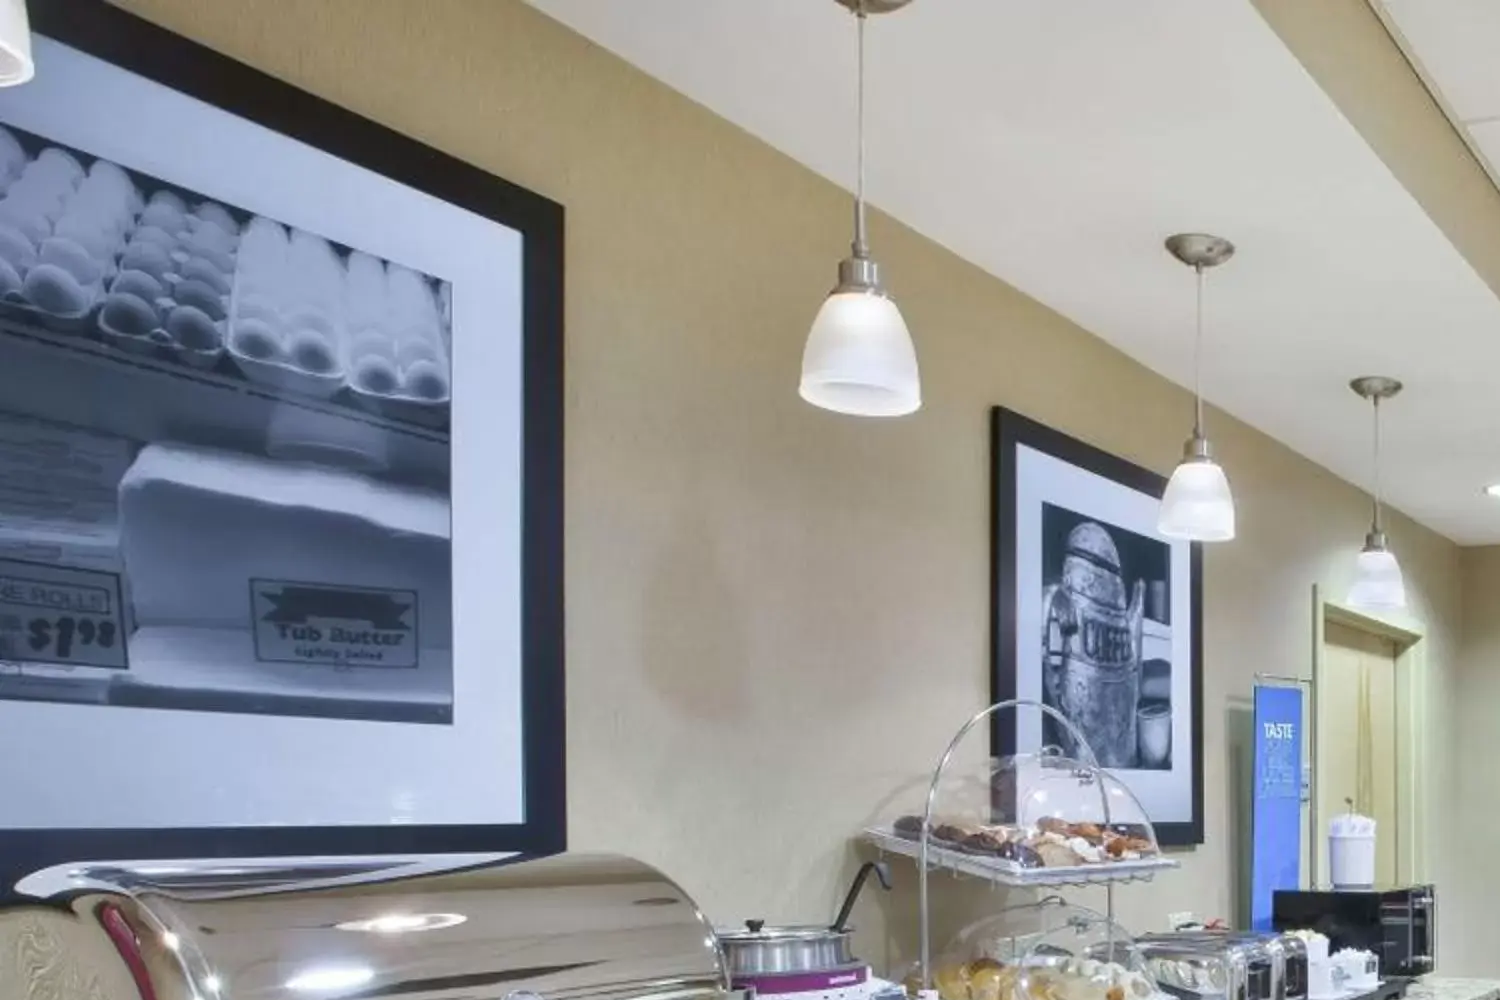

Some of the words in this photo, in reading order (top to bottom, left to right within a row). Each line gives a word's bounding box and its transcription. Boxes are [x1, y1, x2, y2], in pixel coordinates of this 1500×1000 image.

[274, 622, 322, 642] Tub
[329, 626, 405, 646] Butter
[1263, 722, 1297, 739] TASTE
